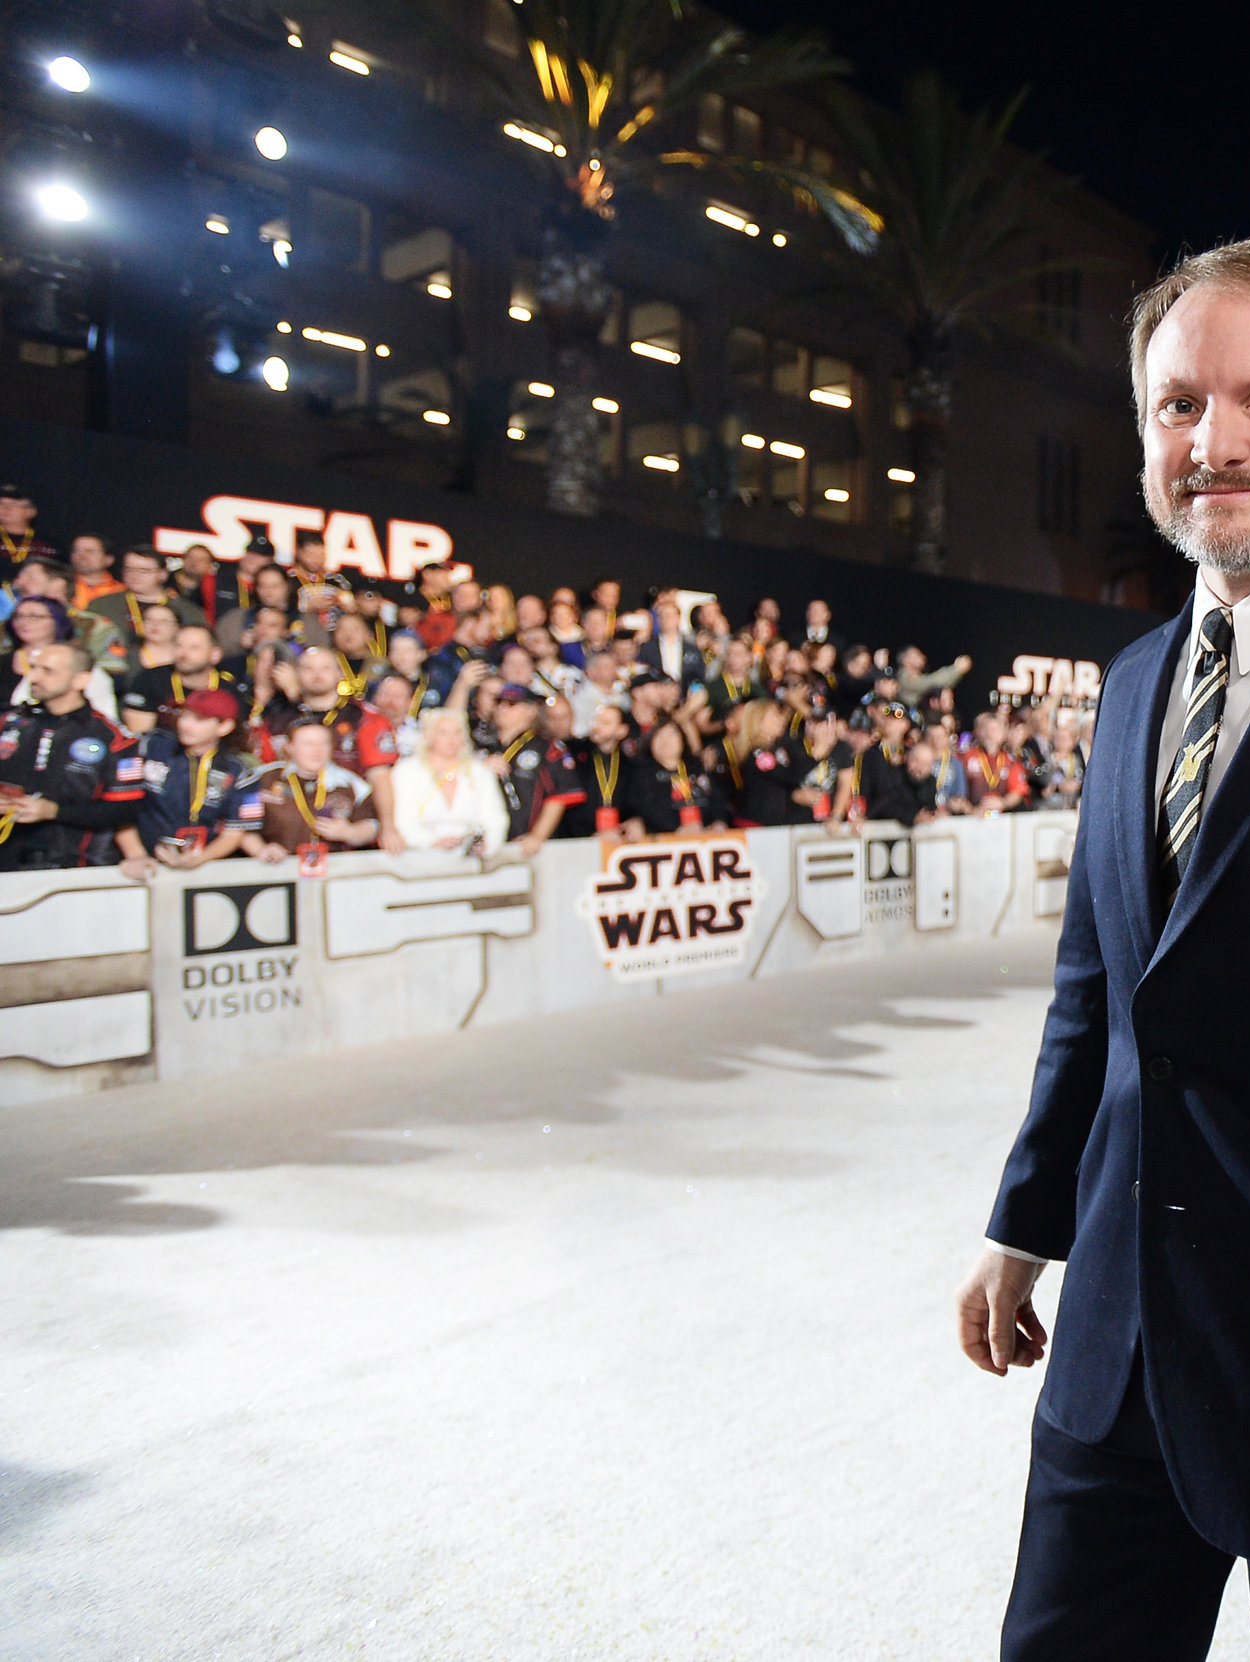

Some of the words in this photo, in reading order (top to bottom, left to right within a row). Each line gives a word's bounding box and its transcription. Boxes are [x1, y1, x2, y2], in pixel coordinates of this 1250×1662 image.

[153, 494, 473, 583] STAR
[997, 654, 1101, 698] STAR
[596, 849, 752, 893] STAR
[598, 899, 752, 950] WARS
[183, 955, 298, 990] DOLBY
[183, 986, 302, 1022] VISION
